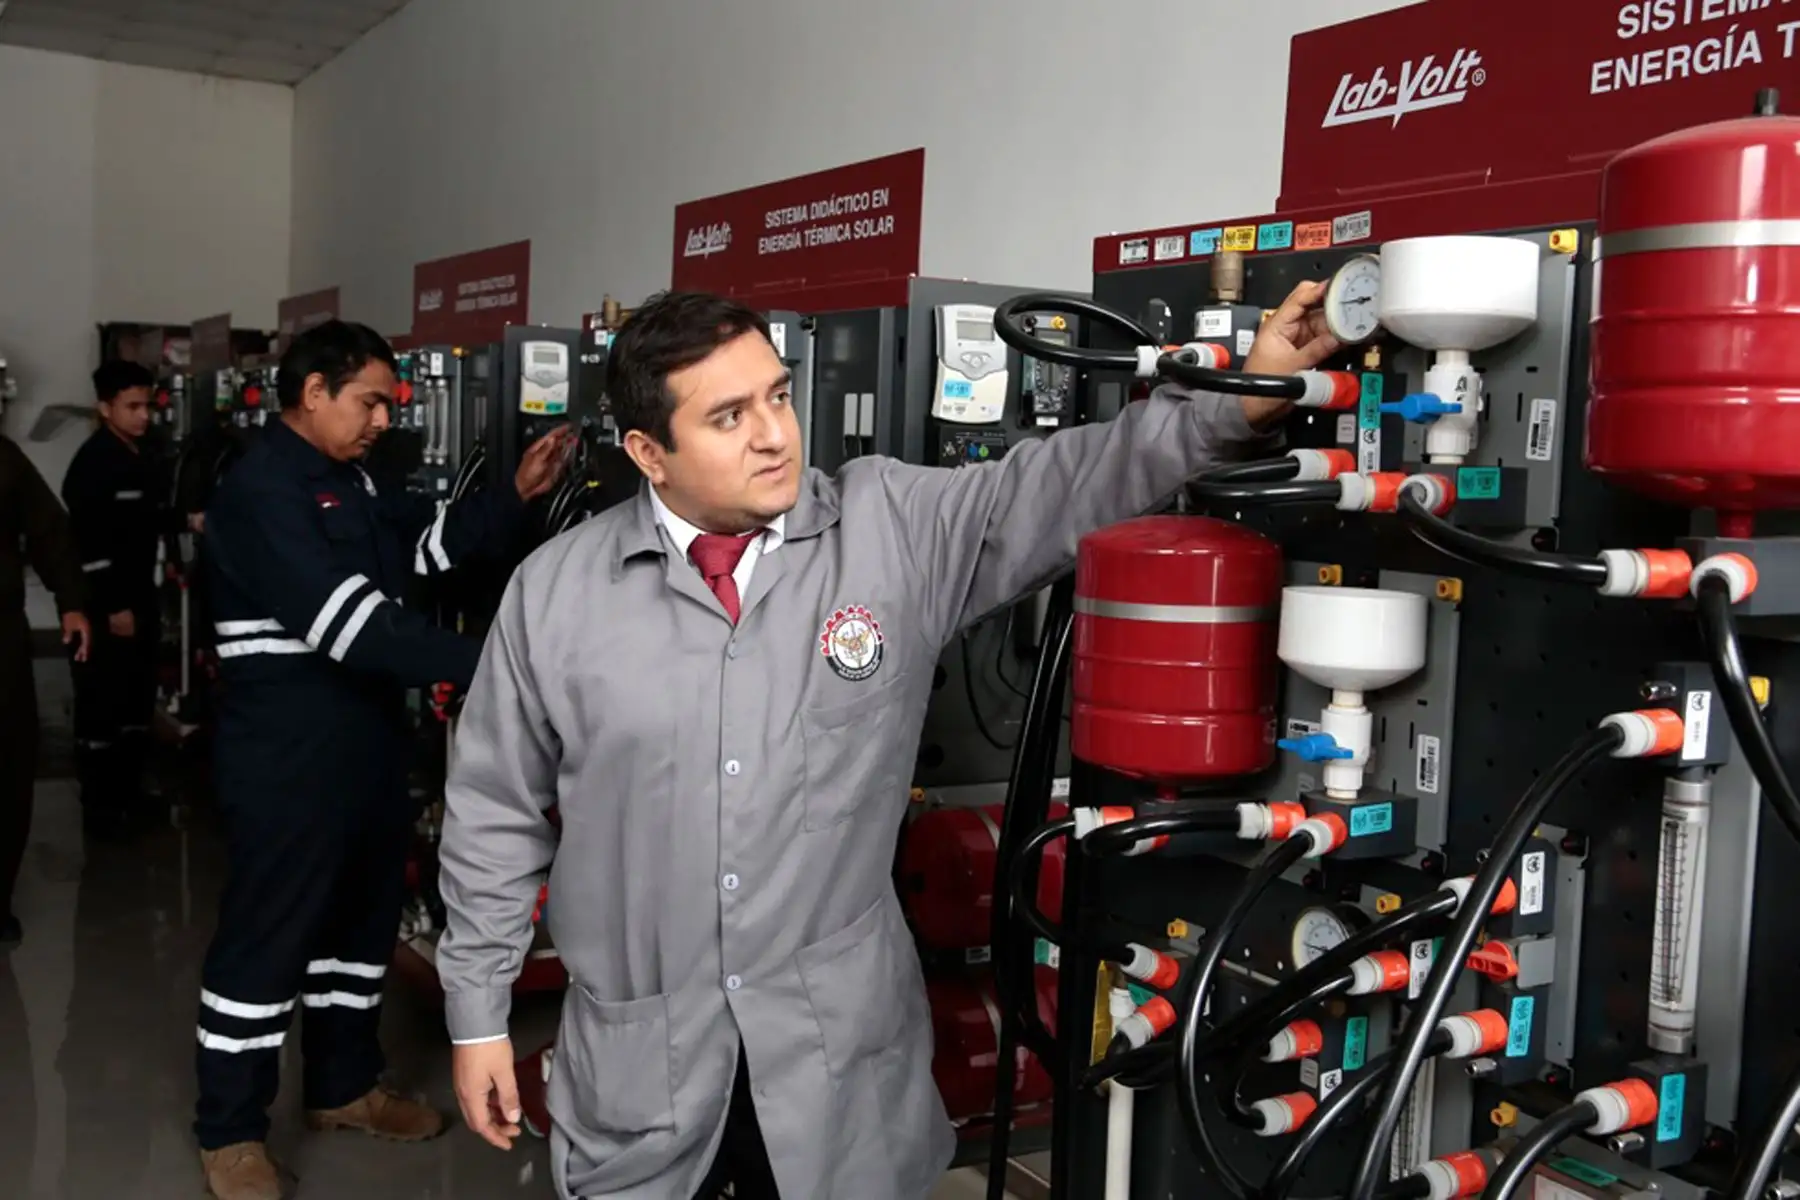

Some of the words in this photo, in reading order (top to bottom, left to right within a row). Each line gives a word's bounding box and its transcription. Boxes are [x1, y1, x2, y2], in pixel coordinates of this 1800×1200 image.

[1590, 23, 1763, 95] ENERGÍA
[765, 204, 809, 229] SISTEMA
[810, 192, 870, 220] DIDÁCTICO
[871, 187, 890, 209] EN
[758, 227, 802, 256] ENERGÍA
[804, 222, 851, 249] TÉRMICA
[853, 215, 894, 240] SOLAR
